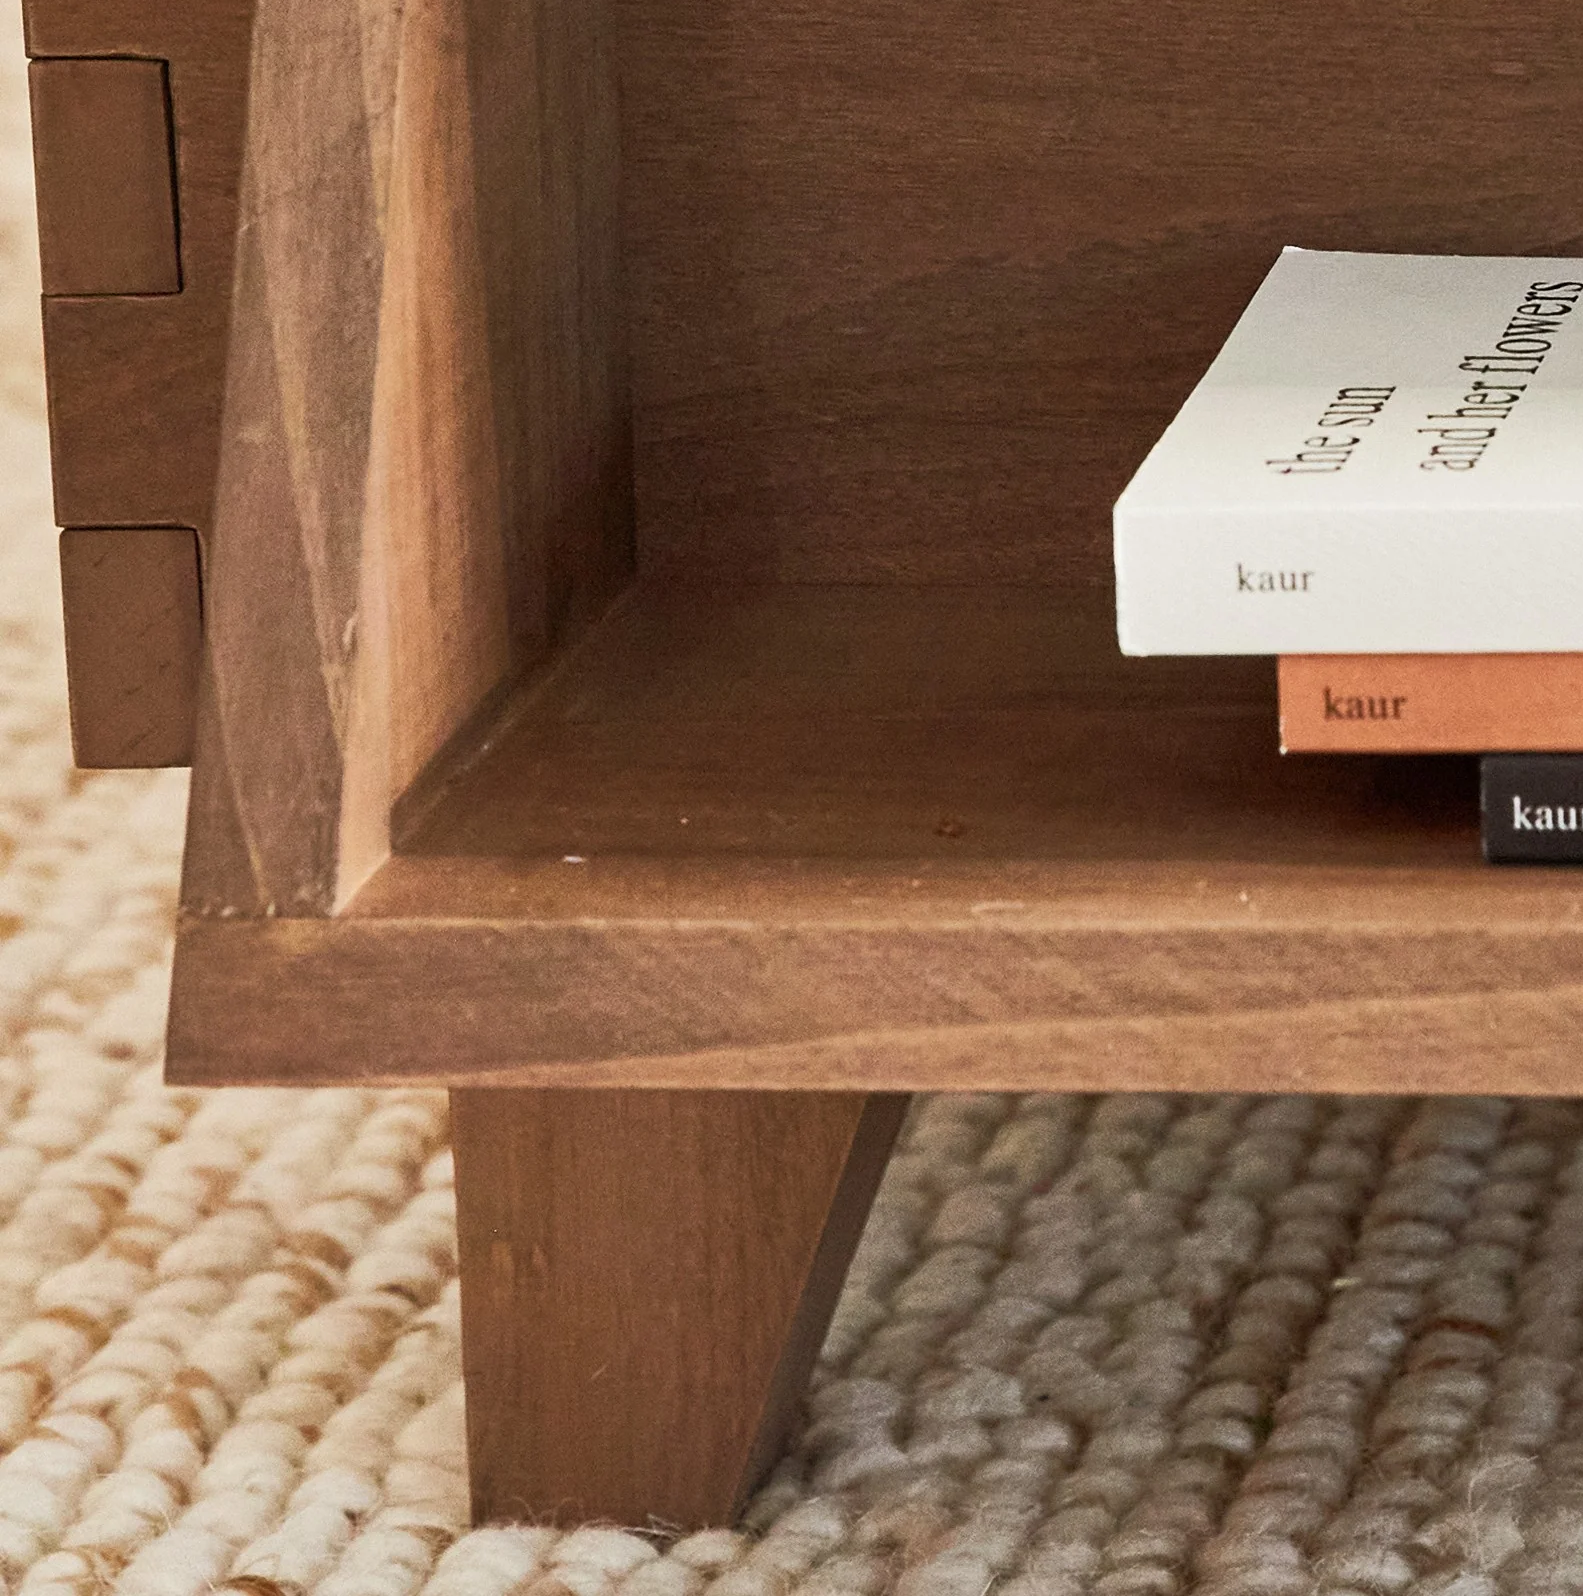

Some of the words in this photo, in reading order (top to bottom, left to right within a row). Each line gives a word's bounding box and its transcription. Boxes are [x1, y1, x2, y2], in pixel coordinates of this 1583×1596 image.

[1426, 380, 1528, 420] her
[1265, 435, 1360, 474] the
[1317, 386, 1397, 427] sun
[1416, 427, 1497, 471] and
[1235, 562, 1315, 592] kaur
[1323, 685, 1408, 721] kaur
